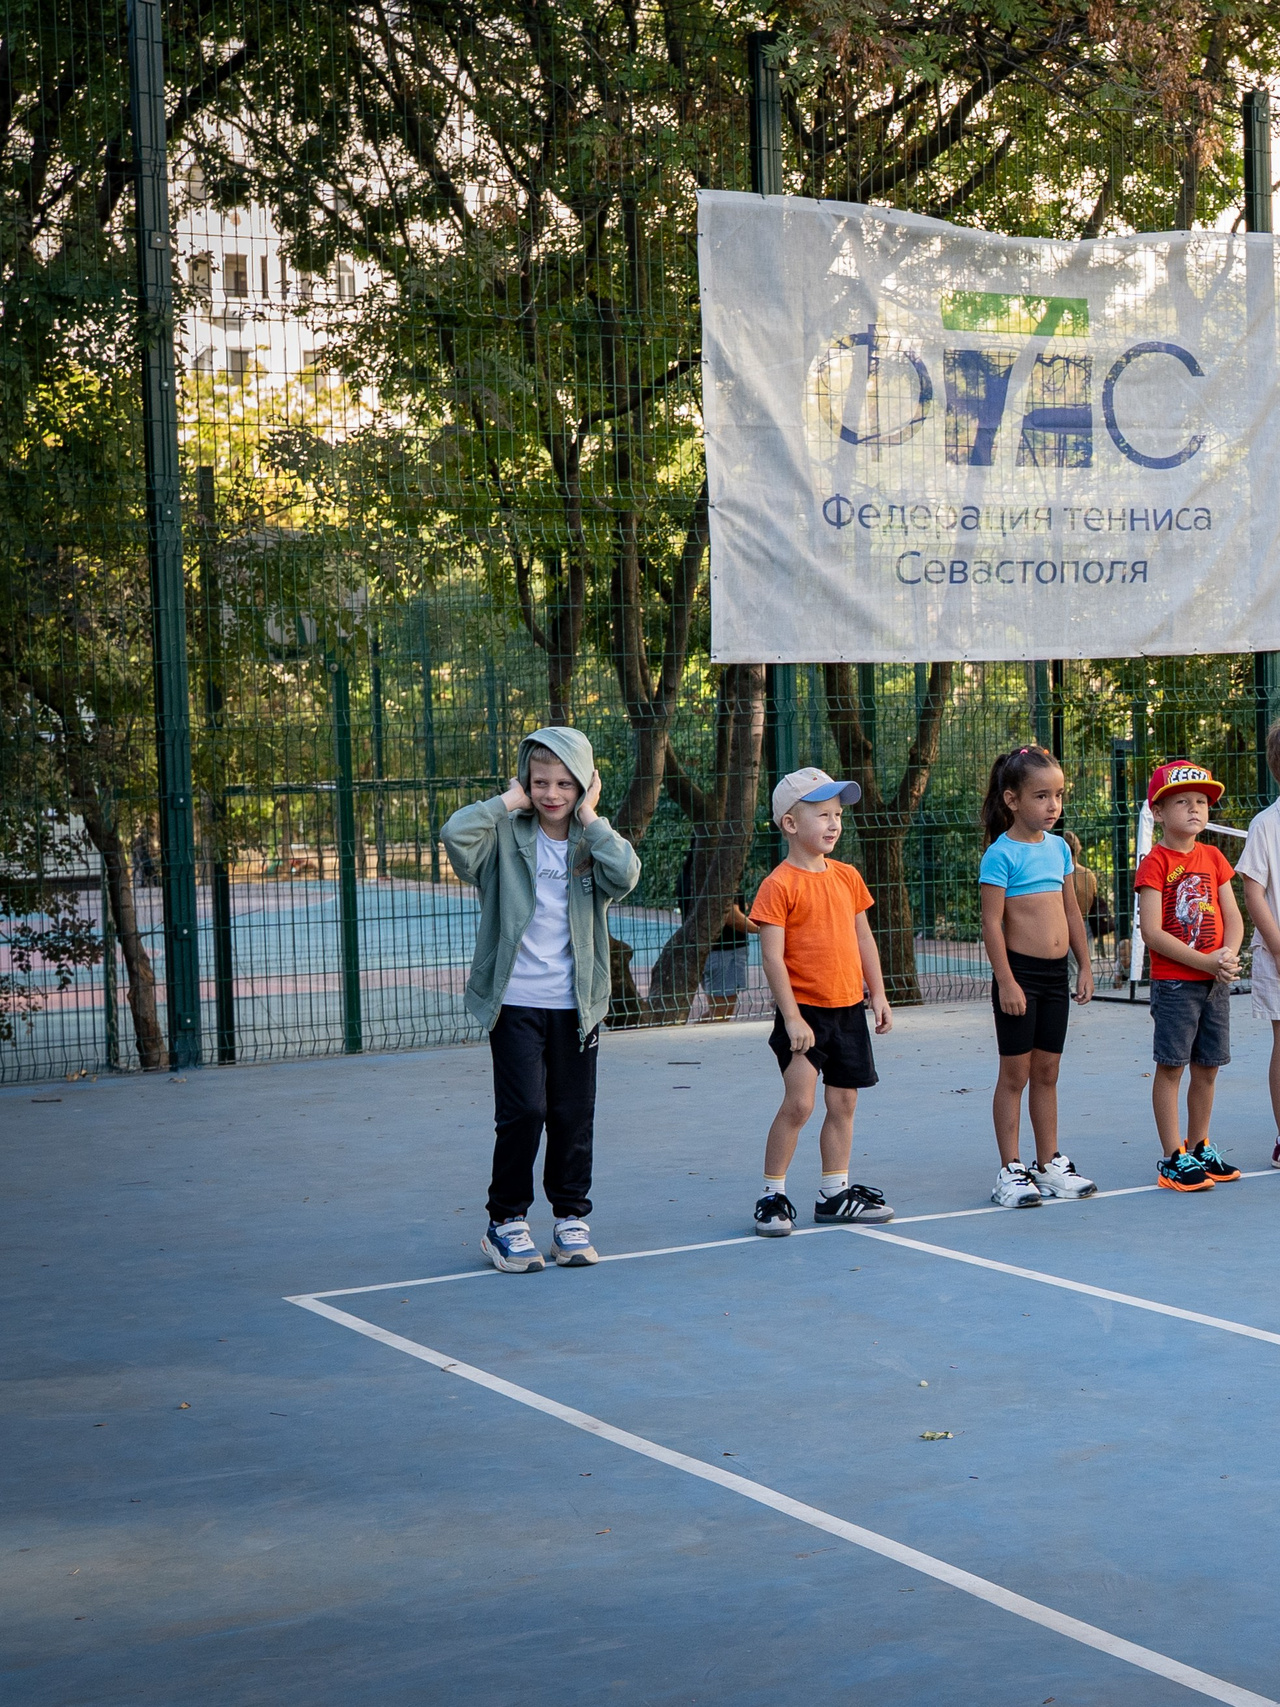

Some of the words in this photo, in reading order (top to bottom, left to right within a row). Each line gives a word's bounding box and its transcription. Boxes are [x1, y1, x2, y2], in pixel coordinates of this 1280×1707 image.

[822, 493, 1052, 539] Федерация
[1063, 507, 1212, 532] тенниса
[895, 550, 1149, 584] Севастополя
[1167, 865, 1185, 882] CRASH
